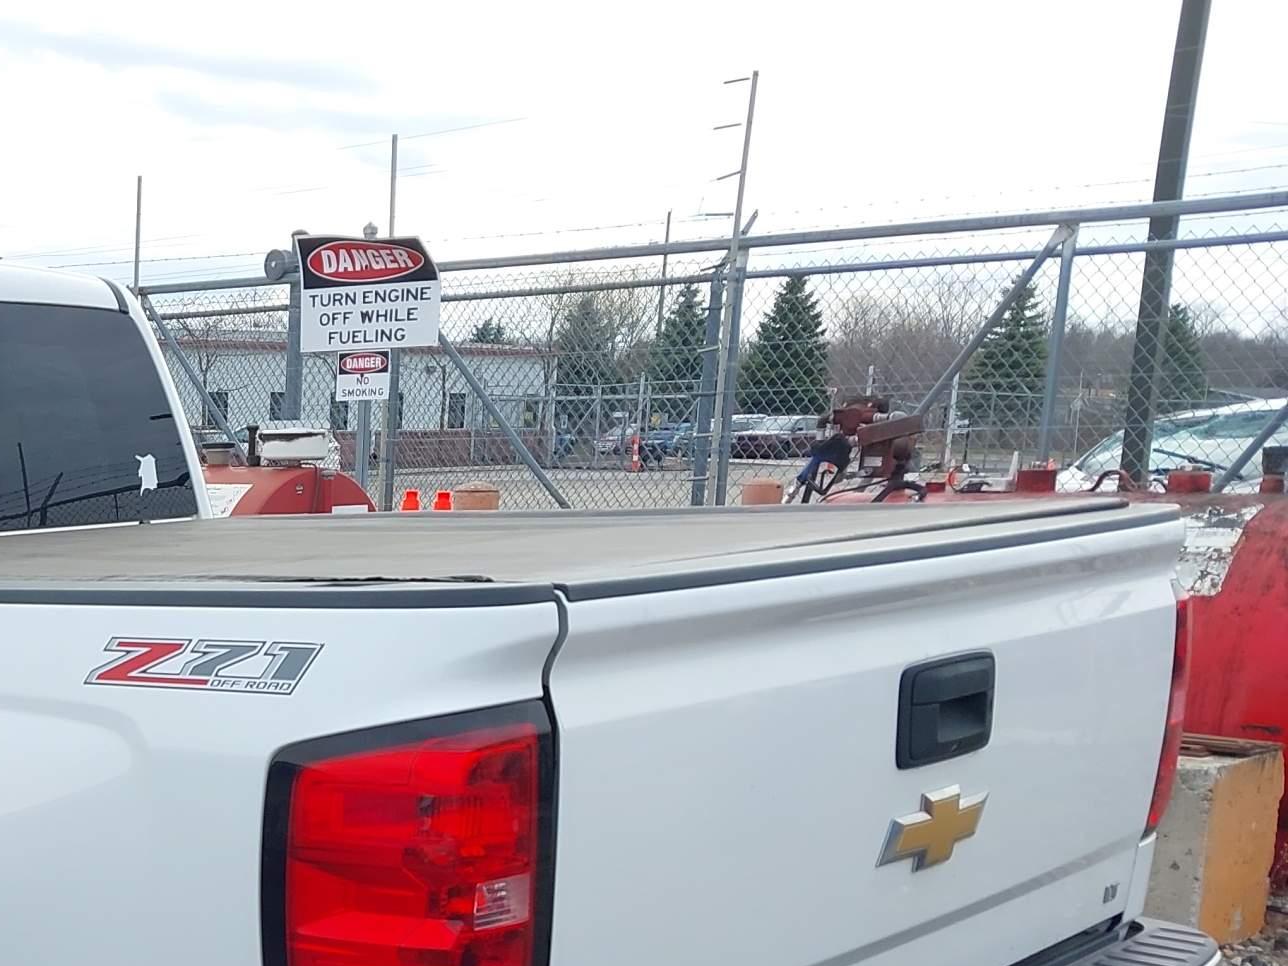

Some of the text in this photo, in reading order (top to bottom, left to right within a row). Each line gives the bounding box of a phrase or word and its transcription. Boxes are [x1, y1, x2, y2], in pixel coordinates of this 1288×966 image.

[321, 249, 414, 274] DANGER
[309, 287, 432, 308] TURN ENGINE
[319, 307, 418, 326] OFF WHILE
[328, 328, 406, 345] FUELING
[346, 356, 382, 369] DANGER
[356, 376, 370, 385] NO
[342, 387, 384, 397] SMOKING
[84, 637, 324, 695] Z71
[210, 679, 292, 691] OFF ROAD
